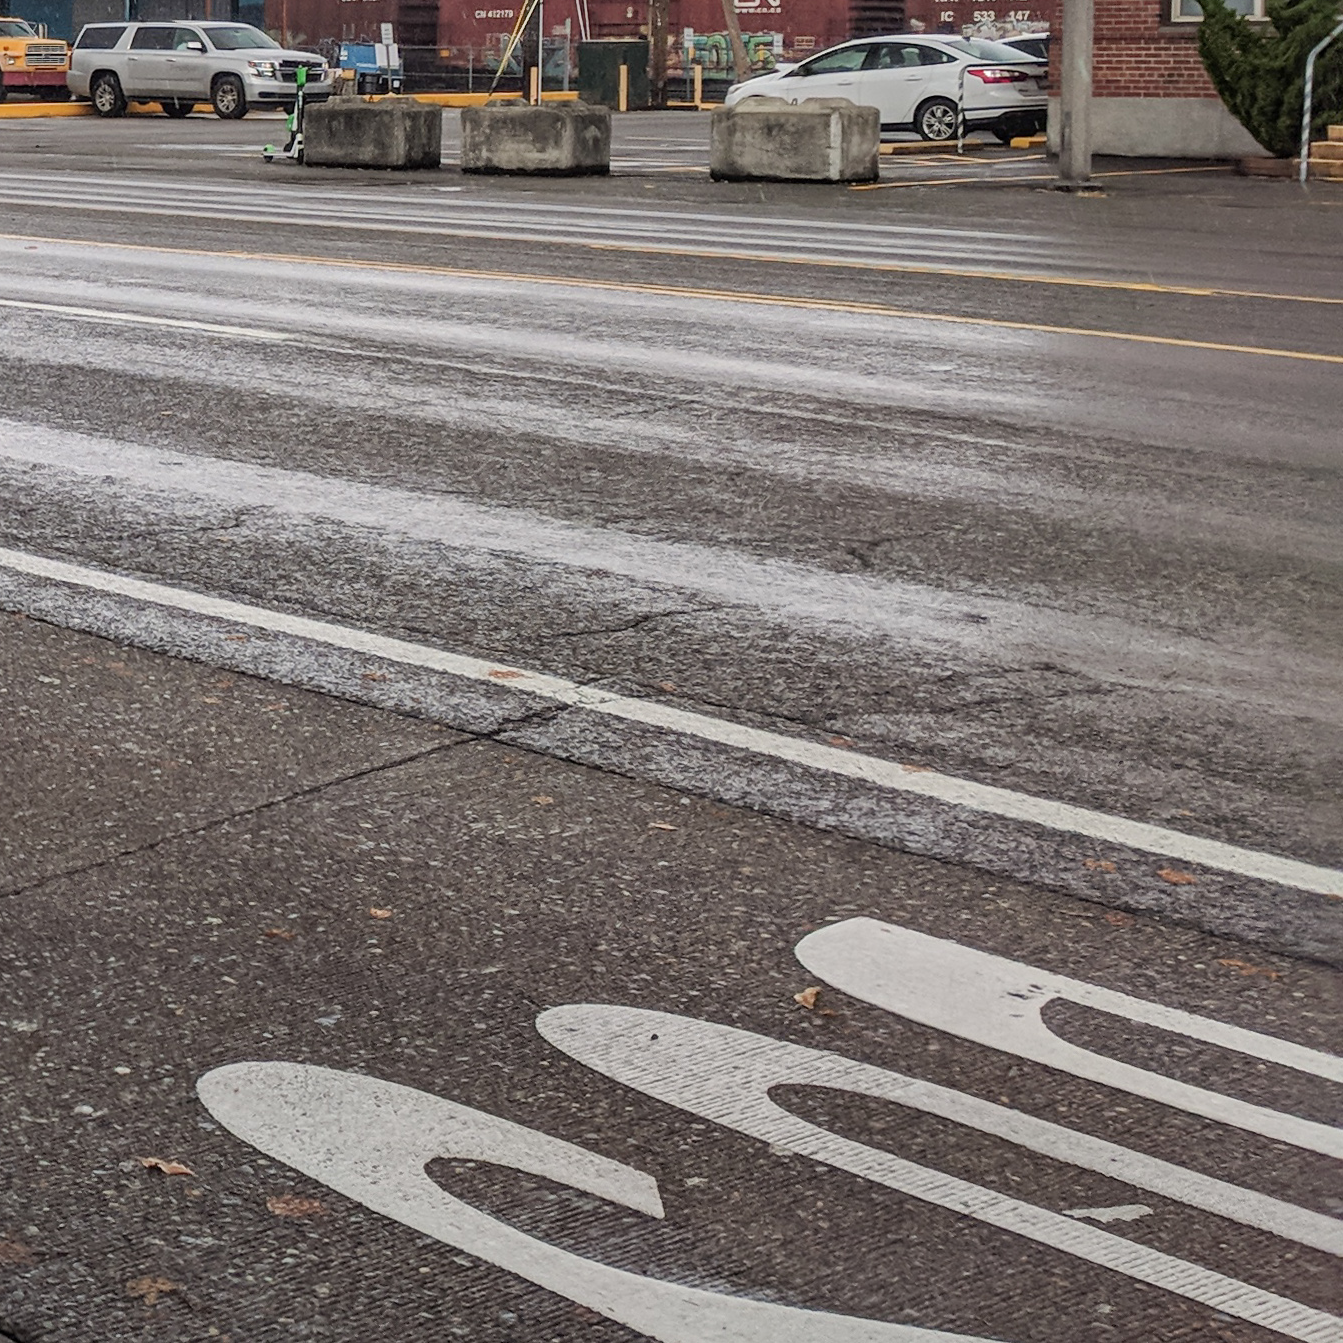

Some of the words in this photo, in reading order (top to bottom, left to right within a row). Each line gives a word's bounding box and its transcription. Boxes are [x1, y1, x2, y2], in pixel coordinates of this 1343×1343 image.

[940, 10, 954, 22] IC
[973, 10, 996, 22] 533
[1008, 10, 1030, 21] 147
